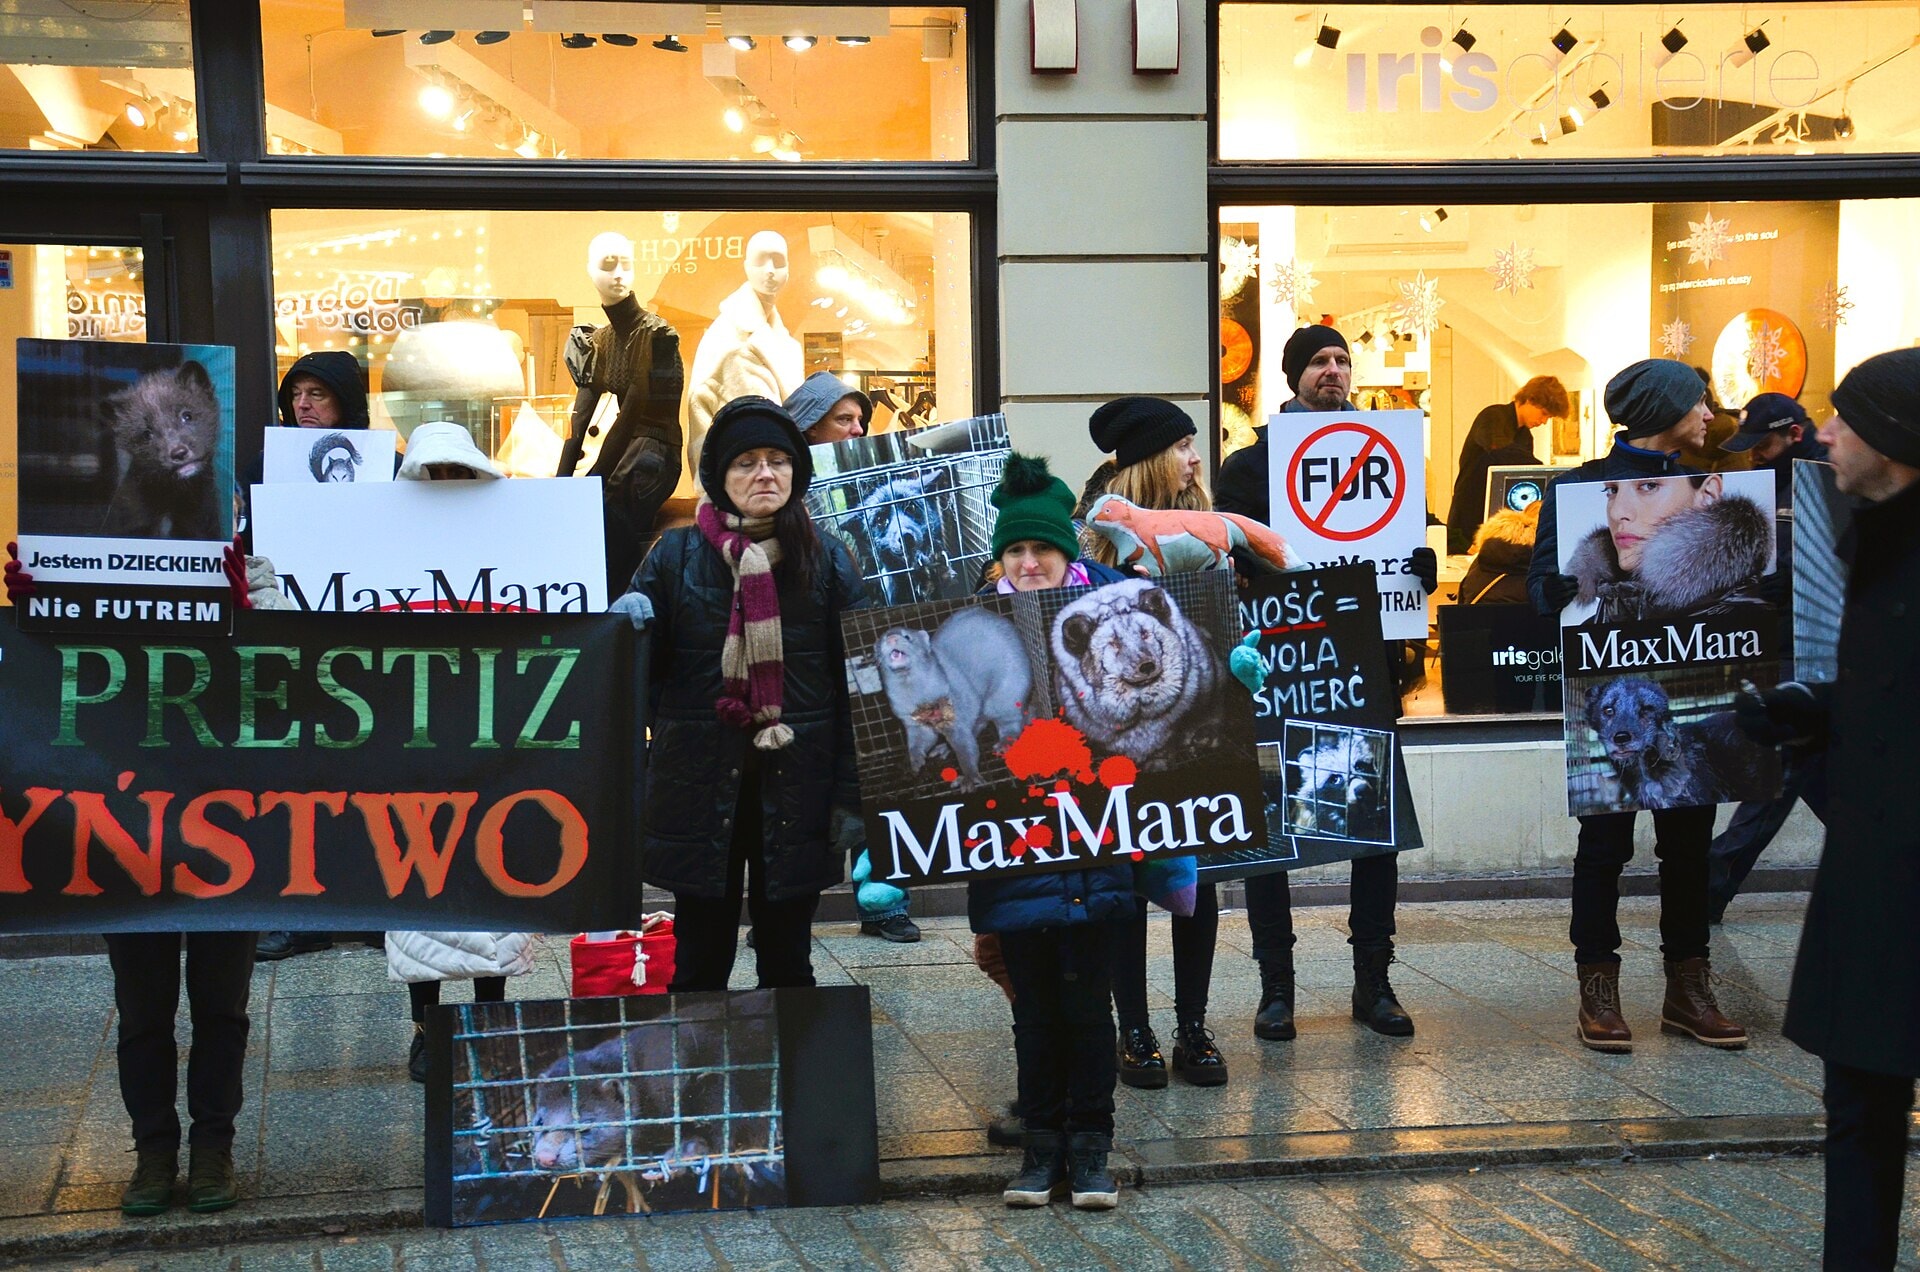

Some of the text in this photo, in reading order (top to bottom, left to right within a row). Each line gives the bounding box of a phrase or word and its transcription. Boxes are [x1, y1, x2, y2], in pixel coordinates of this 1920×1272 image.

[1346, 26, 1819, 139] irisgalerie
[1301, 455, 1393, 502] FUR
[28, 551, 222, 573] Jestem DZIECKIEM
[29, 597, 220, 622] Nie FUTREM
[275, 567, 589, 613] MaxMara
[1577, 622, 1763, 671] MaxMara
[50, 635, 581, 749] PRESTIŻ
[1514, 674, 1533, 683] YOUR
[1535, 673, 1546, 682] EYE
[0, 771, 588, 899] YŃSTWO
[878, 783, 1253, 880] MaxMara
